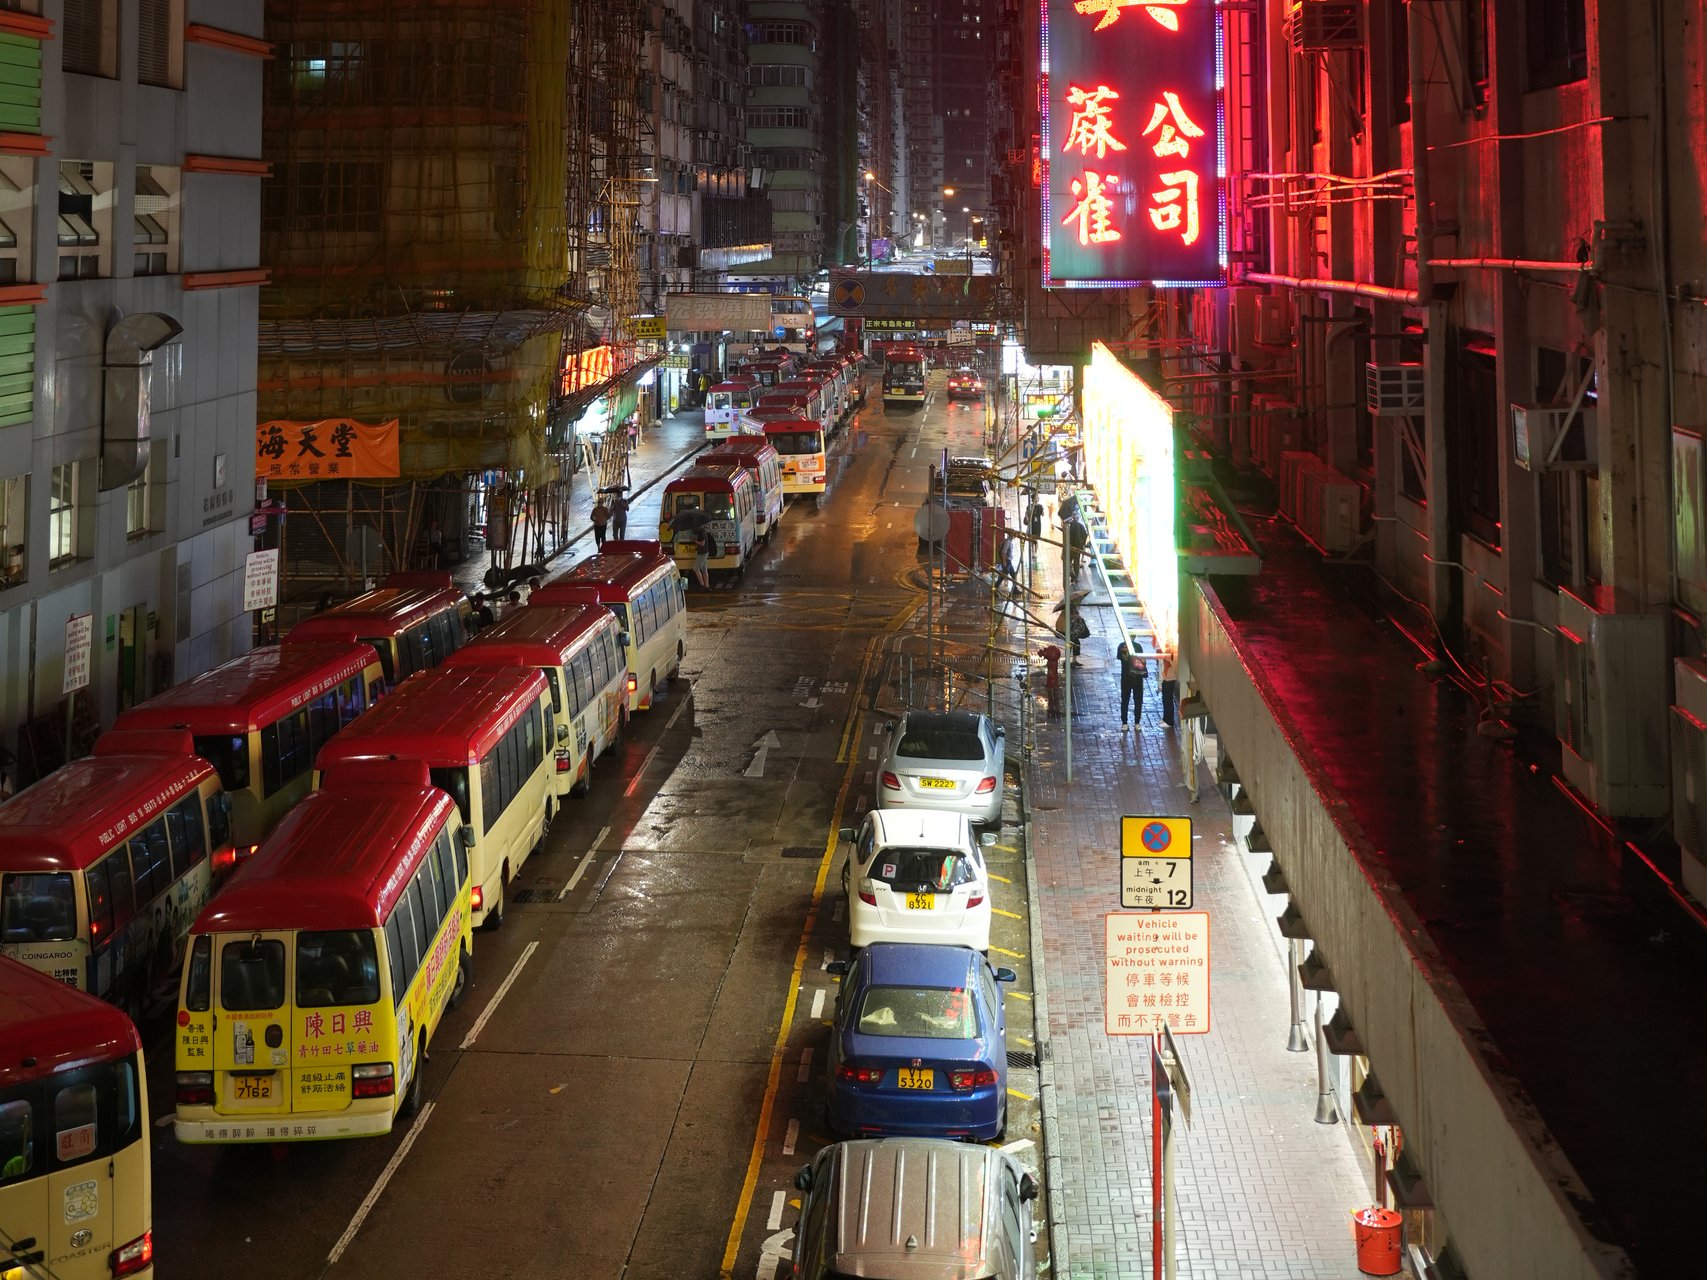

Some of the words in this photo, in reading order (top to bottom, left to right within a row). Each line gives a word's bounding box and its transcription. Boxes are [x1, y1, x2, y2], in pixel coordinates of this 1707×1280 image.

[1143, 91, 1205, 246] 公司
[258, 423, 358, 459] 海天堂
[270, 462, 340, 475] 照常營業
[934, 780, 955, 788] 2227
[99, 828, 116, 847] PUBLIC
[114, 819, 128, 835] LIGHT
[128, 812, 138, 824] BUS
[143, 799, 157, 813] SEATS
[885, 865, 894, 876] P
[1134, 868, 1154, 878] 上午
[1166, 862, 1177, 878] 7
[1126, 886, 1162, 895] midnight
[1167, 889, 1187, 906] 12
[1134, 895, 1154, 905] 午夜
[1137, 920, 1178, 928] Vehicle
[1117, 933, 1159, 943] waiting
[1162, 932, 1182, 941] will
[1185, 932, 1198, 941] be
[22, 952, 73, 960] COINGAROO
[1126, 945, 1189, 956] prosecuted
[1111, 958, 1156, 967] without
[1159, 957, 1204, 967] warning
[1126, 973, 1190, 987] 停車等候
[1126, 993, 1190, 1008] 會被檢控
[305, 1010, 373, 1039] 陳日興
[1118, 1013, 1198, 1028] 而不予警告
[187, 1024, 204, 1033] 香港
[182, 1036, 209, 1045] 陳日興
[187, 1047, 205, 1057] 監製
[298, 1041, 379, 1059] 青竹田七草藥油
[301, 1072, 346, 1083] 超級止痛
[908, 1068, 924, 1078] VT
[244, 1077, 263, 1088] LT
[900, 1078, 932, 1089] 5320
[237, 1087, 270, 1098] 7162
[301, 1084, 346, 1094] 舒筋活絡
[62, 1129, 91, 1149] 旺角
[50, 1242, 112, 1264] COASTER
